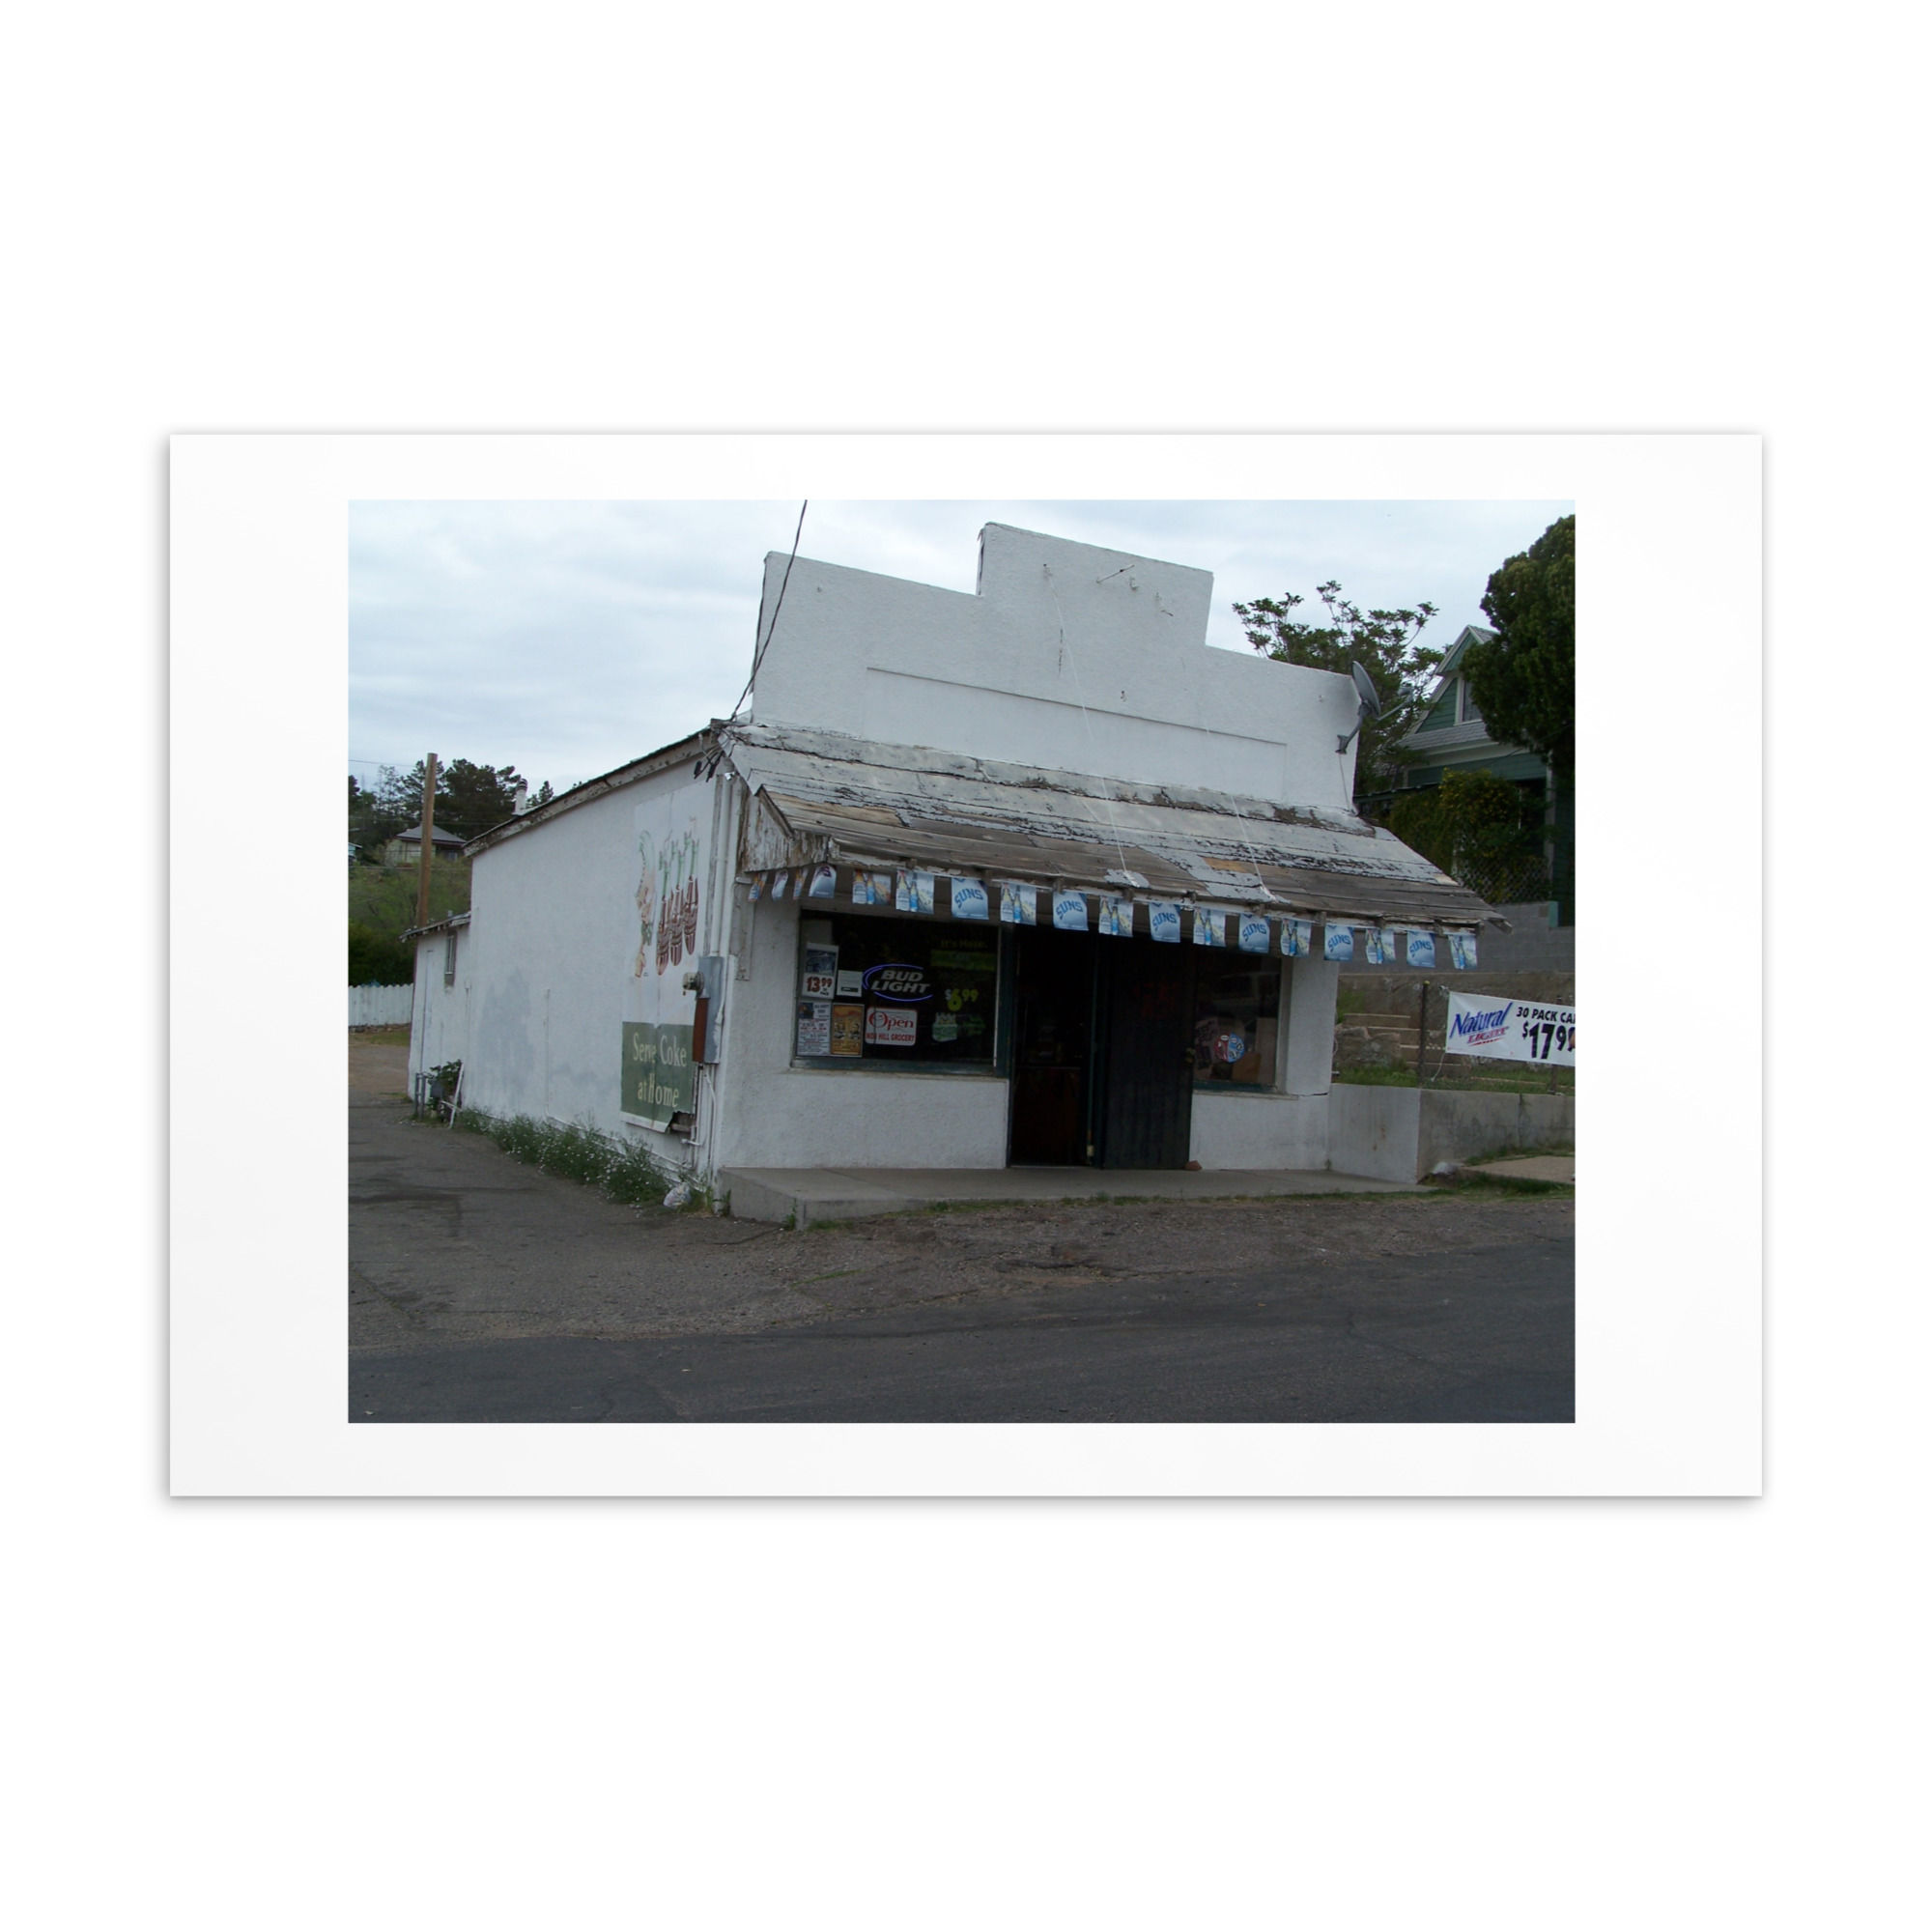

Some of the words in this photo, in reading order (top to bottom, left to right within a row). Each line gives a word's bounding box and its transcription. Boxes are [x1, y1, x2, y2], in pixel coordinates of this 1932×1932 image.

[954, 888, 983, 909] SUNS
[1056, 899, 1083, 920] SUNS
[1152, 912, 1178, 931] SUNS
[1242, 923, 1266, 942] SUNS
[1327, 934, 1350, 952] SUNS
[1409, 940, 1433, 958] SUNS
[881, 970, 924, 982] BUD
[870, 980, 931, 993] LIGHT
[868, 1011, 914, 1031] Open
[1449, 1002, 1514, 1039] Natural
[1516, 1007, 1529, 1017] 30
[1531, 1009, 1558, 1022] PACK
[1560, 1012, 1575, 1024] CA
[633, 1032, 657, 1064] Serve
[660, 1035, 688, 1067] Coke
[638, 1079, 648, 1101] at
[648, 1072, 679, 1108] Home
